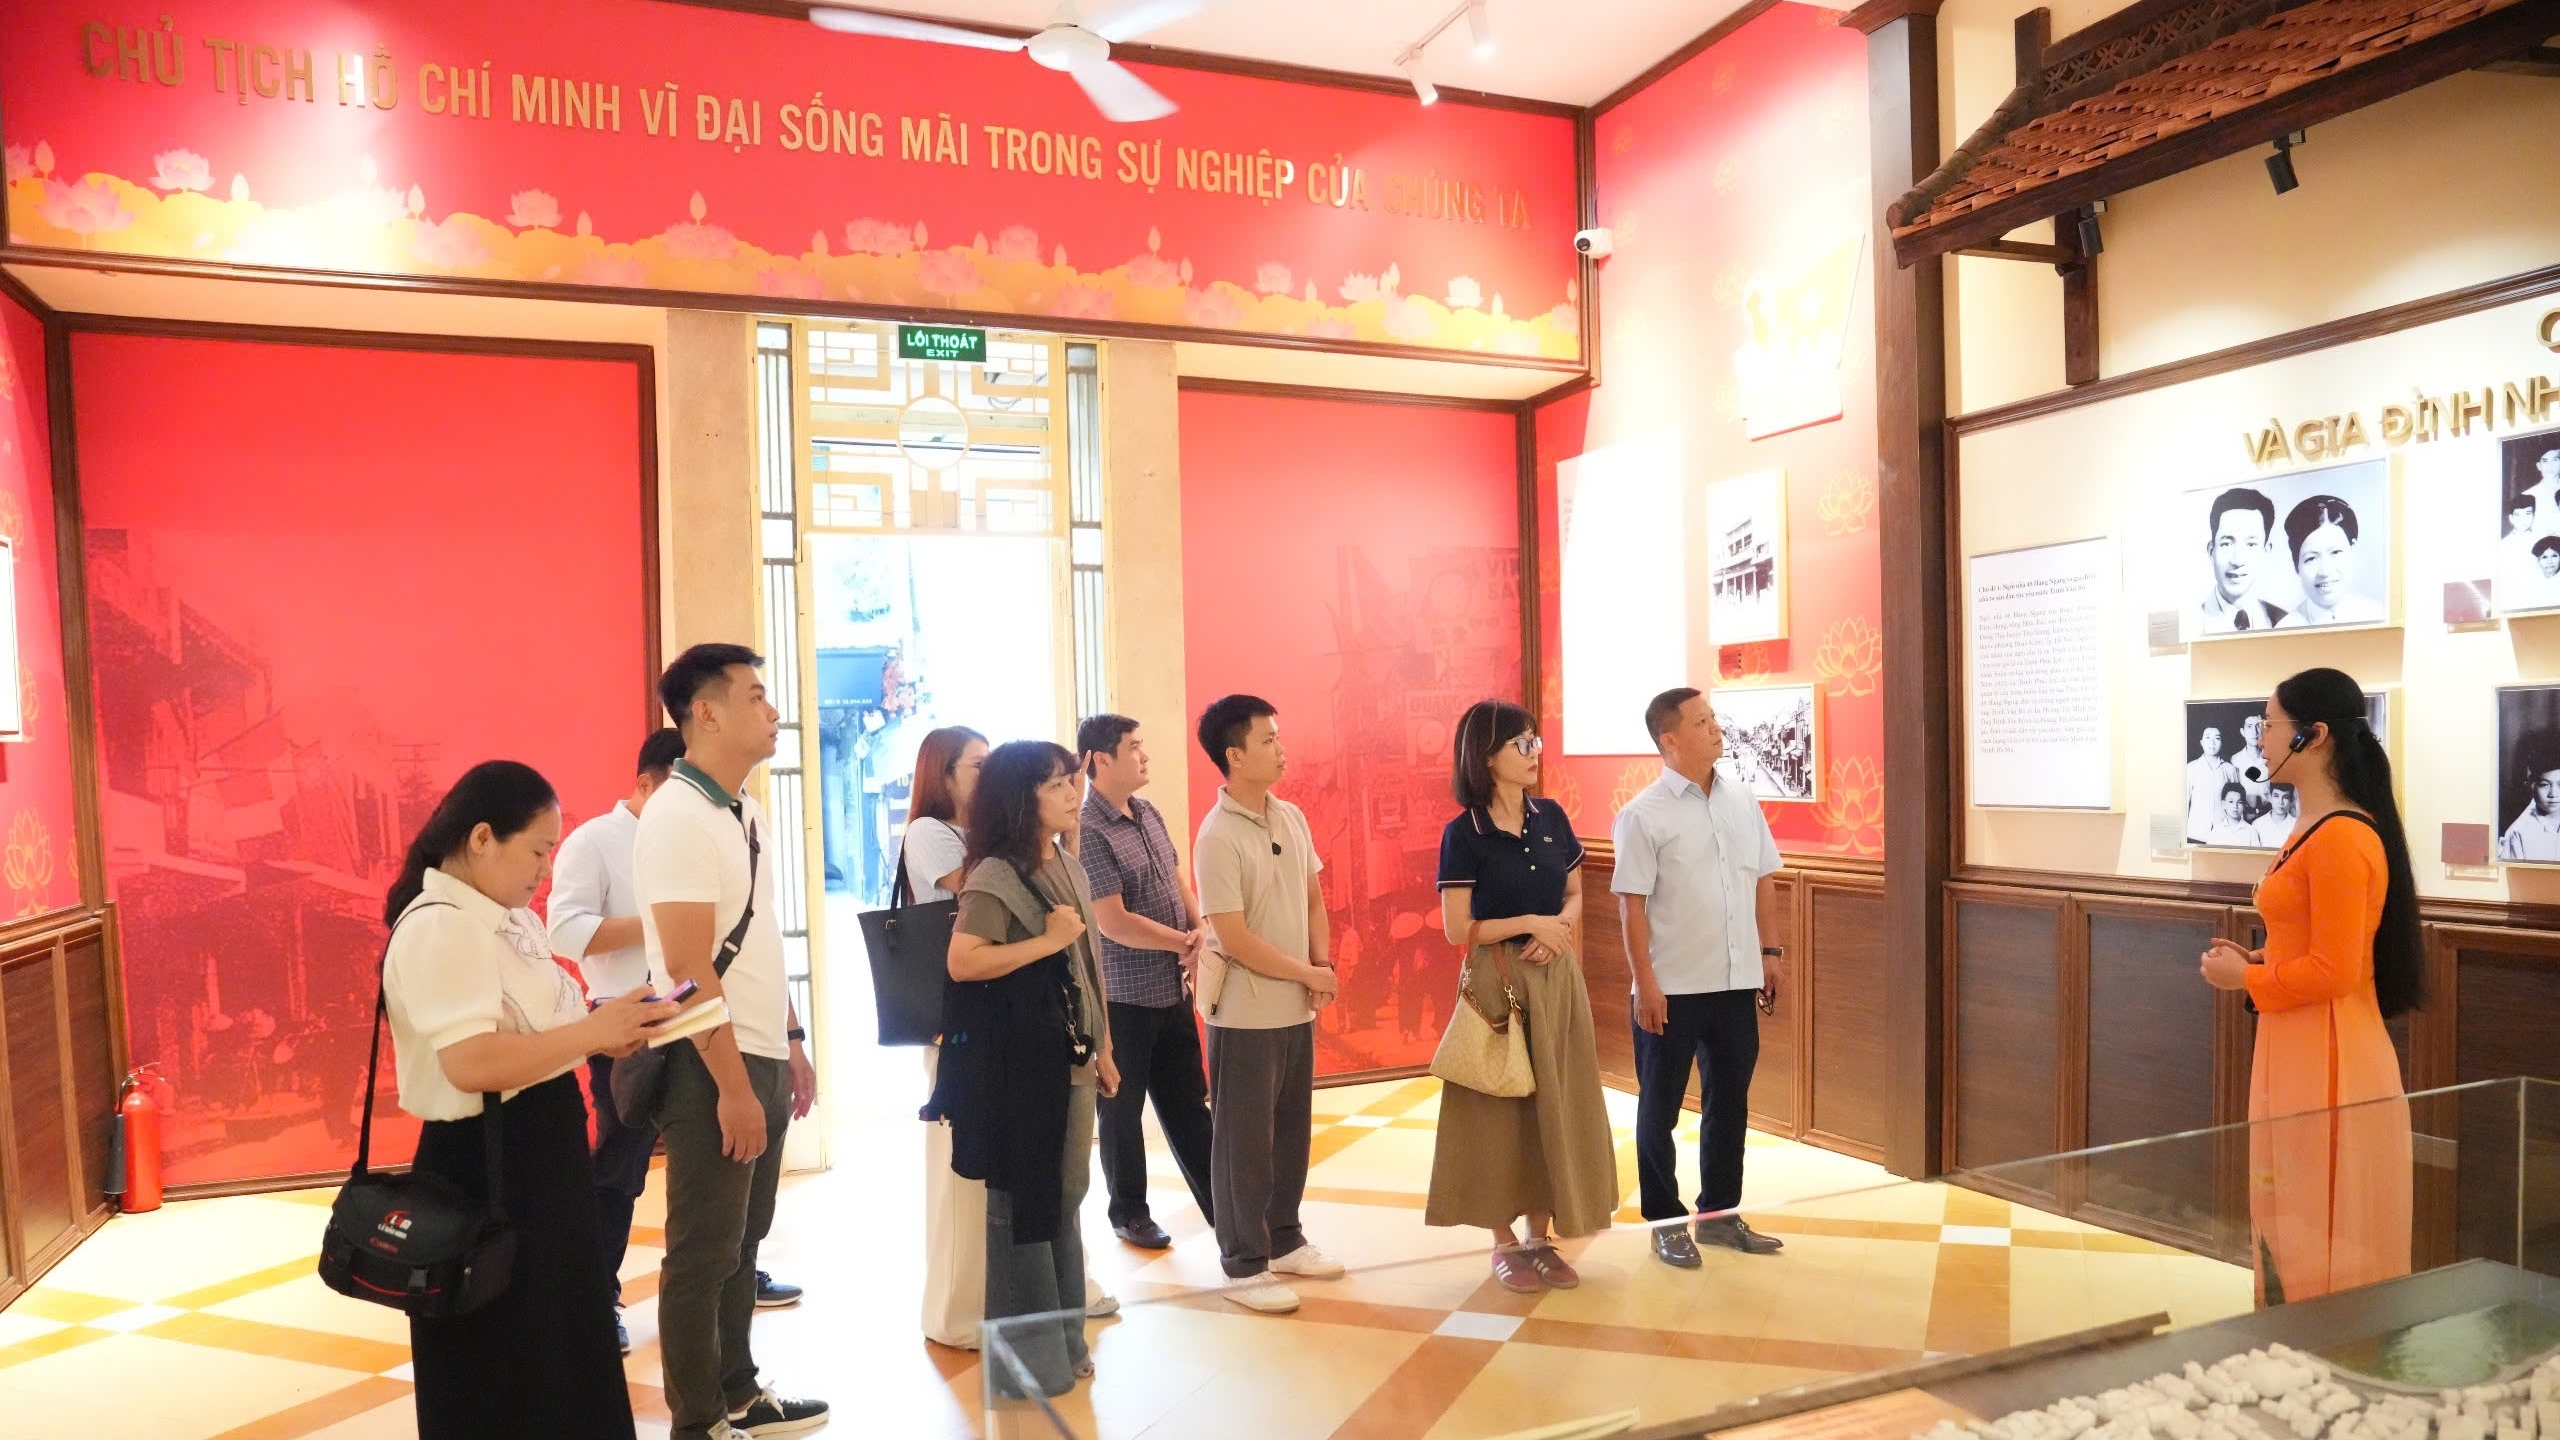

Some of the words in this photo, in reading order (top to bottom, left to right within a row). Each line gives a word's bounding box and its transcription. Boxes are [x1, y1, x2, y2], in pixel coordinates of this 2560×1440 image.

[81, 13, 184, 86] CHỦ
[204, 36, 314, 106] TỊCH
[418, 60, 491, 119] CHÍ
[511, 74, 620, 132] MINH
[639, 81, 679, 137] VĨ
[695, 94, 761, 154] ĐẠI
[779, 91, 884, 158] SỐNG
[901, 112, 969, 166] MÃI
[984, 125, 1102, 180] TRONG
[1117, 138, 1162, 194] SỰ
[1176, 148, 1294, 207] NGHIỆP
[1307, 152, 1369, 211] CỦA
[1384, 169, 1485, 224] CHÚNG
[1494, 184, 1531, 230] TA
[926, 349, 959, 358] EXIT
[932, 333, 978, 349] THOÁT
[2242, 417, 2293, 466] VÀ
[2294, 411, 2369, 462] GIA
[2378, 386, 2494, 447] ĐÌNH
